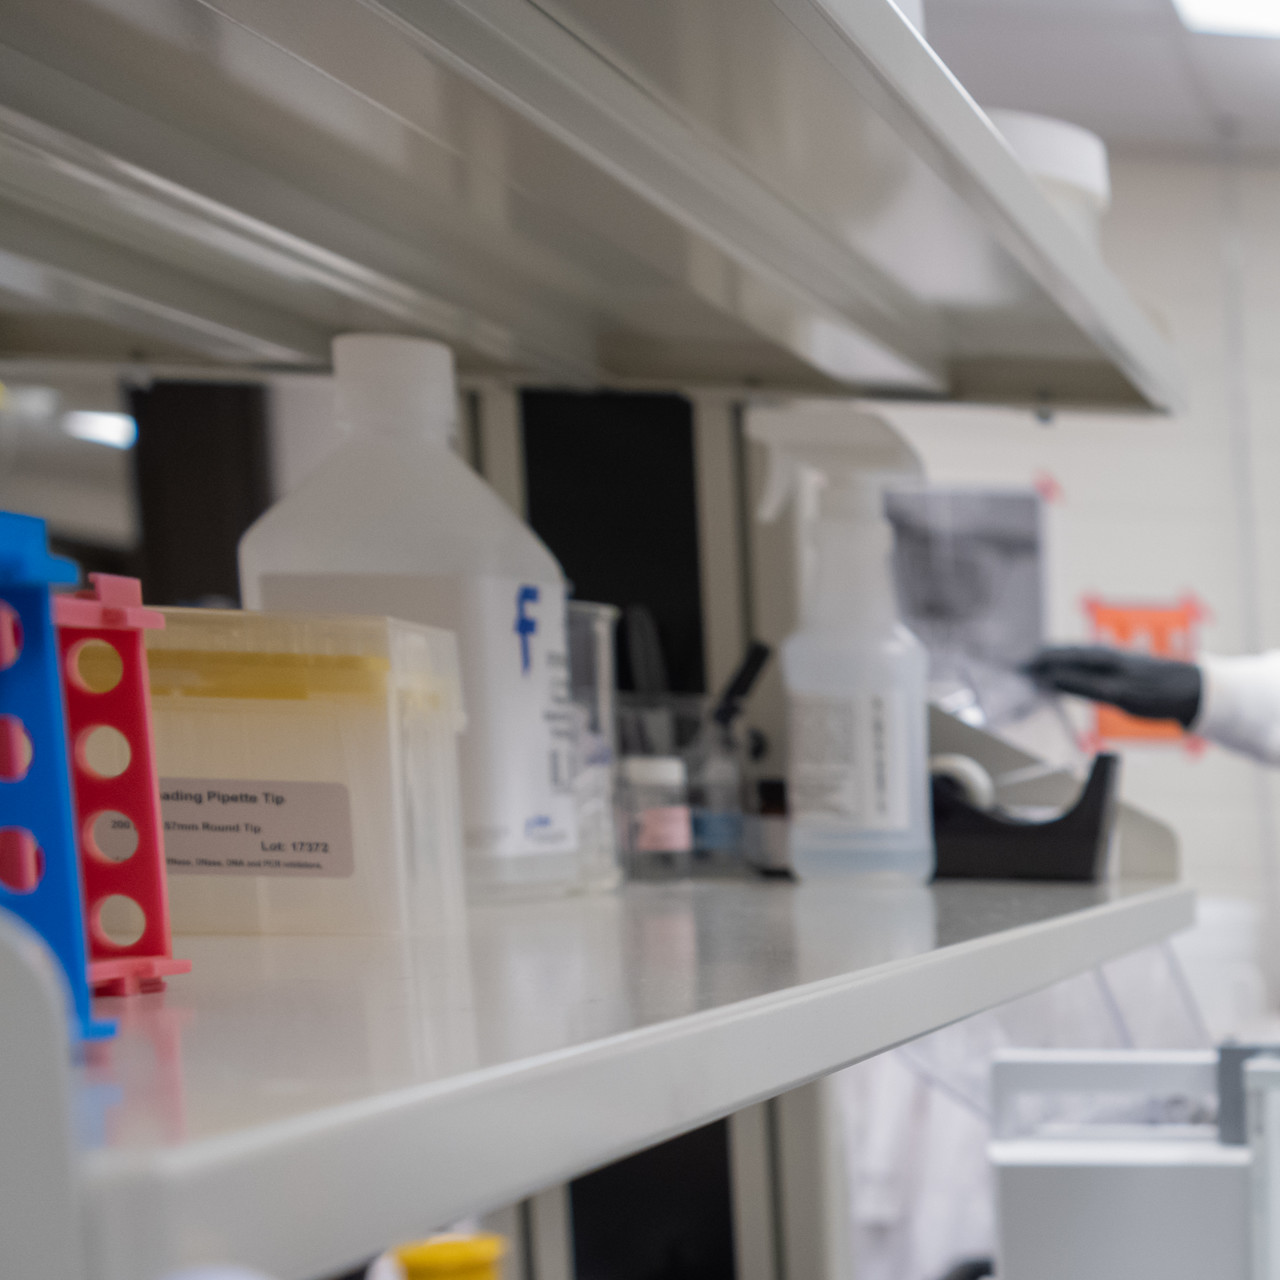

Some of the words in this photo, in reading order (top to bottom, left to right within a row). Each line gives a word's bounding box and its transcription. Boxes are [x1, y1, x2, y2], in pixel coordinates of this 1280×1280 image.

[206, 789, 258, 806] Pipette
[262, 791, 285, 806] Tip
[202, 821, 240, 832] Round
[244, 822, 262, 834] Tip
[261, 841, 285, 852] Lot:
